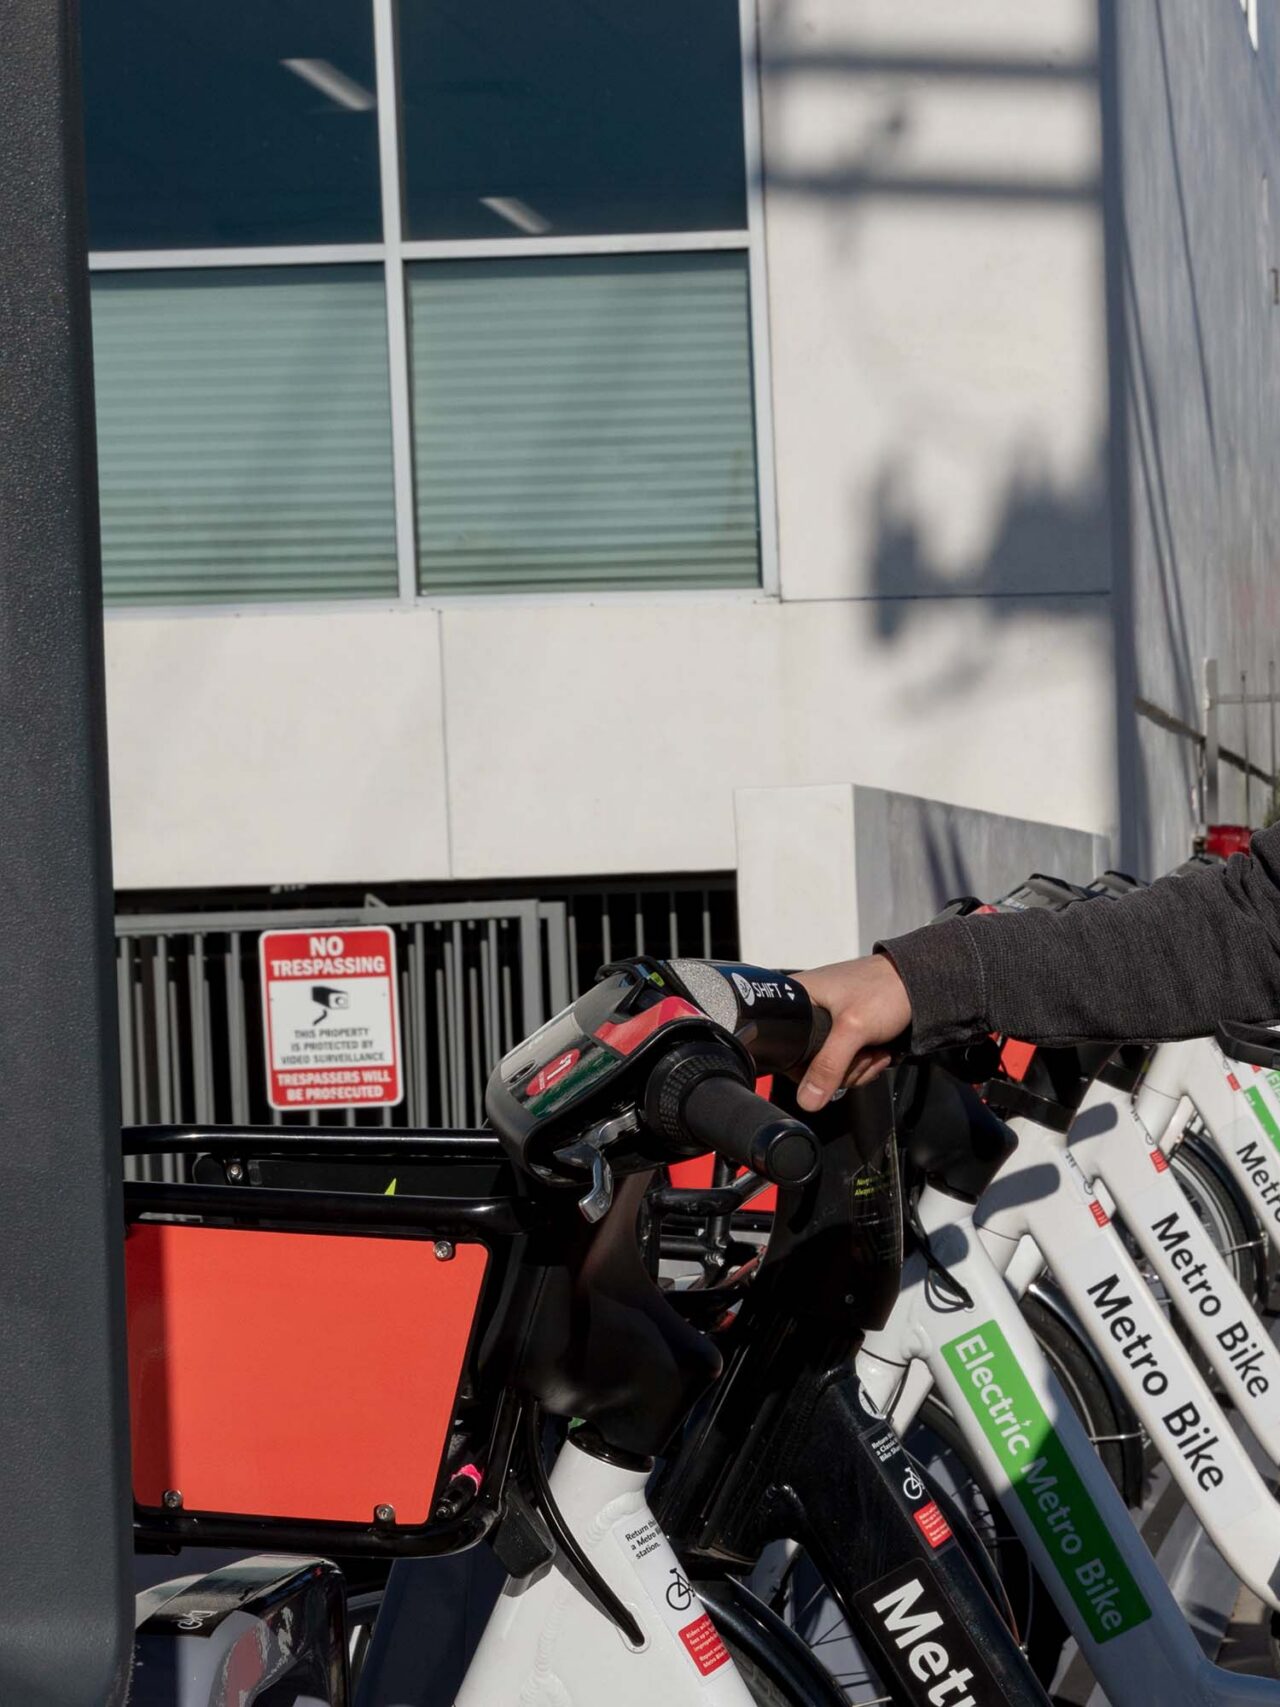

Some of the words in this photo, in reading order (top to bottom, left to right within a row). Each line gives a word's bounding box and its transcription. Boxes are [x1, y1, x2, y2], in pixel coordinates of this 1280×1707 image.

[309, 936, 344, 957] NO
[270, 956, 386, 977] TRESPASSING
[751, 982, 782, 998] SHIFT
[294, 1029, 316, 1039] THIS
[319, 1028, 369, 1038] PROPERTY
[291, 1043, 300, 1052] IS
[304, 1041, 359, 1051] PROTECTED
[361, 1040, 374, 1050] BY
[281, 1055, 311, 1065] VIDEO
[314, 1053, 385, 1063] SURVEILLANCE
[277, 1070, 361, 1086] TRESPASSERS
[361, 1069, 392, 1083] WILL
[286, 1088, 304, 1102] BE
[305, 1085, 384, 1100] PROSECUTED
[1151, 1212, 1222, 1317] Metro
[1216, 1320, 1270, 1398] Bike
[1086, 1273, 1169, 1396] Metro
[1162, 1401, 1224, 1492] Bike
[954, 1333, 1032, 1456] Electric
[1020, 1456, 1082, 1555] Metro
[1075, 1557, 1123, 1631] Bike
[625, 1525, 649, 1541] Return
[636, 1532, 656, 1547] Metro
